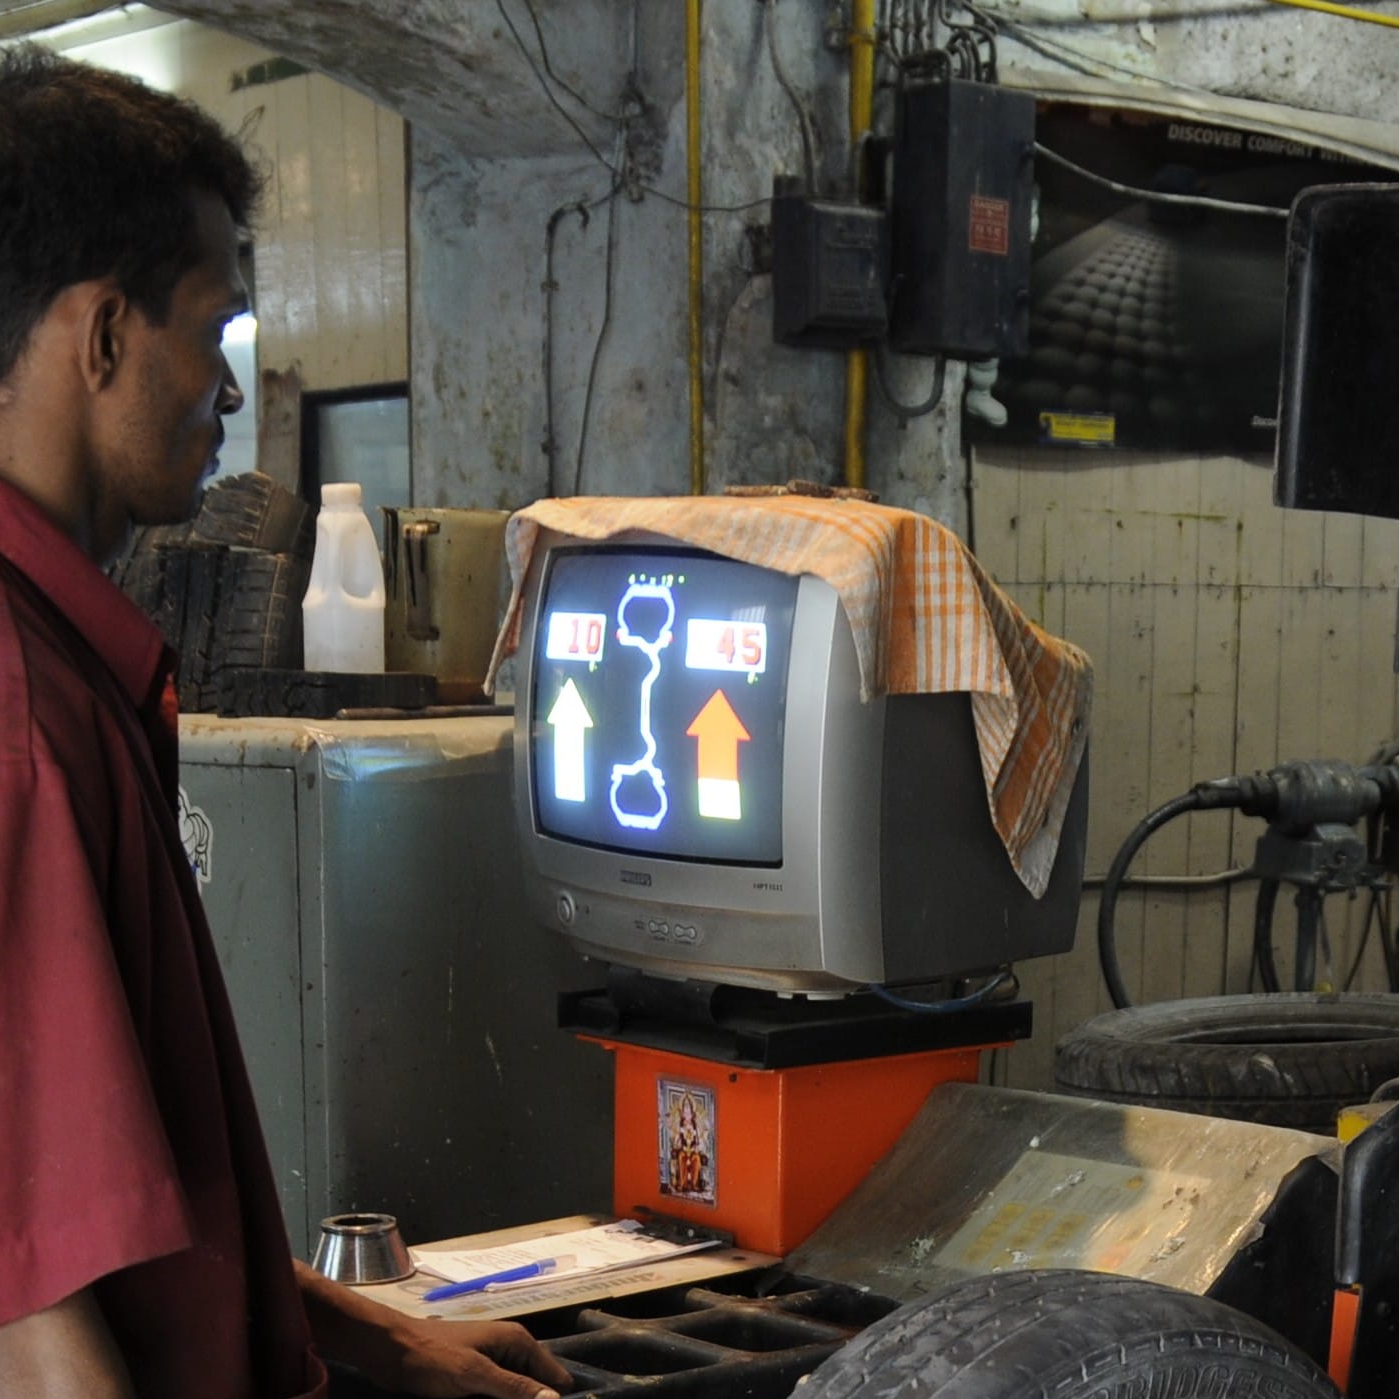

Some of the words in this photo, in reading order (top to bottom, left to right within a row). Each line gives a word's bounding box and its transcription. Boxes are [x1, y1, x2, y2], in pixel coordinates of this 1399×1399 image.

[1168, 123, 1242, 148] DISCOVER
[1247, 134, 1314, 159] COMFORT
[568, 618, 602, 655] 10
[717, 626, 762, 665] 45
